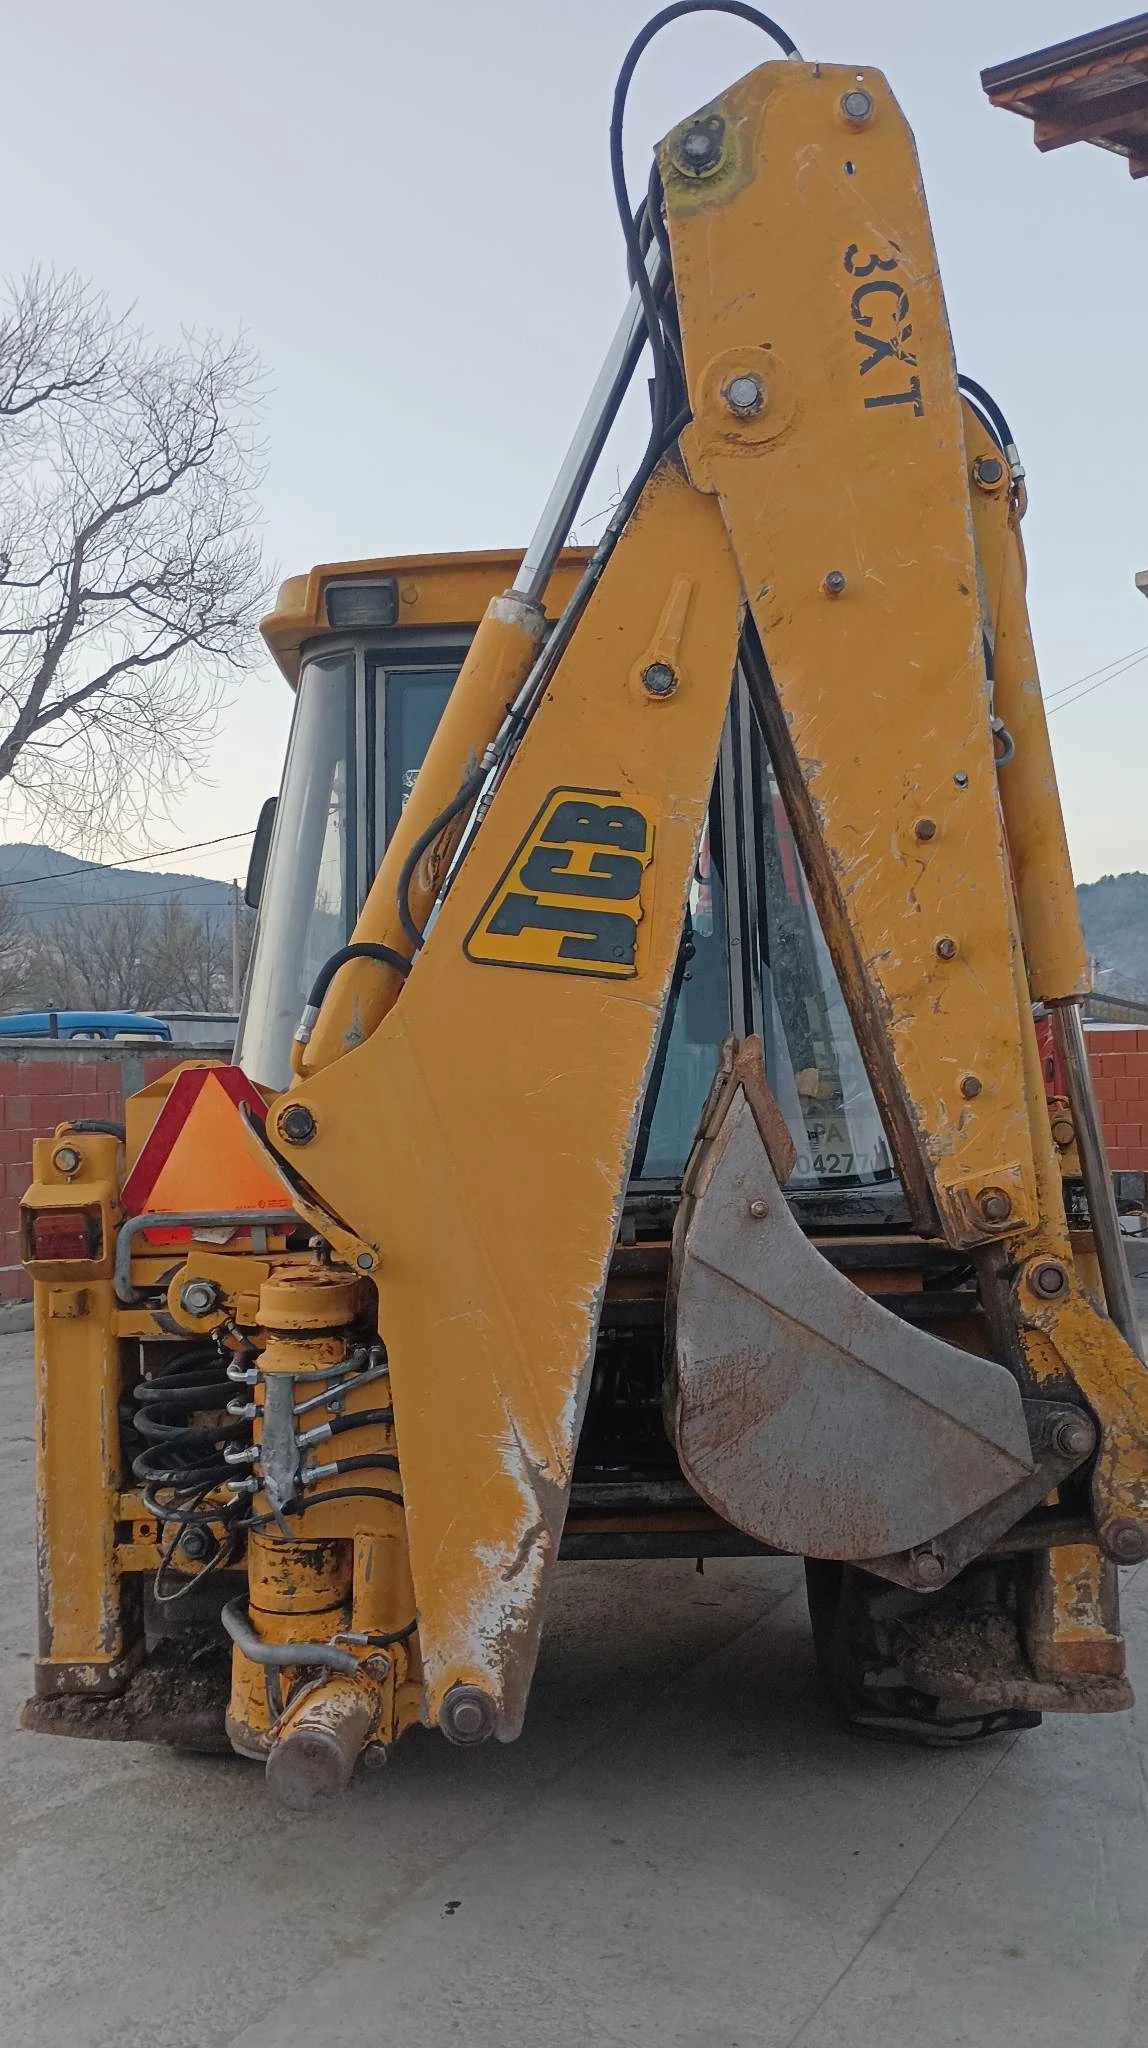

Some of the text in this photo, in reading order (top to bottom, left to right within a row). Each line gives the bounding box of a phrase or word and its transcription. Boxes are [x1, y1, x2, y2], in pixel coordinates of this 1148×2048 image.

[843, 241, 925, 418] 3CXT
[486, 801, 648, 965] JCB
[812, 1123, 845, 1144] PA
